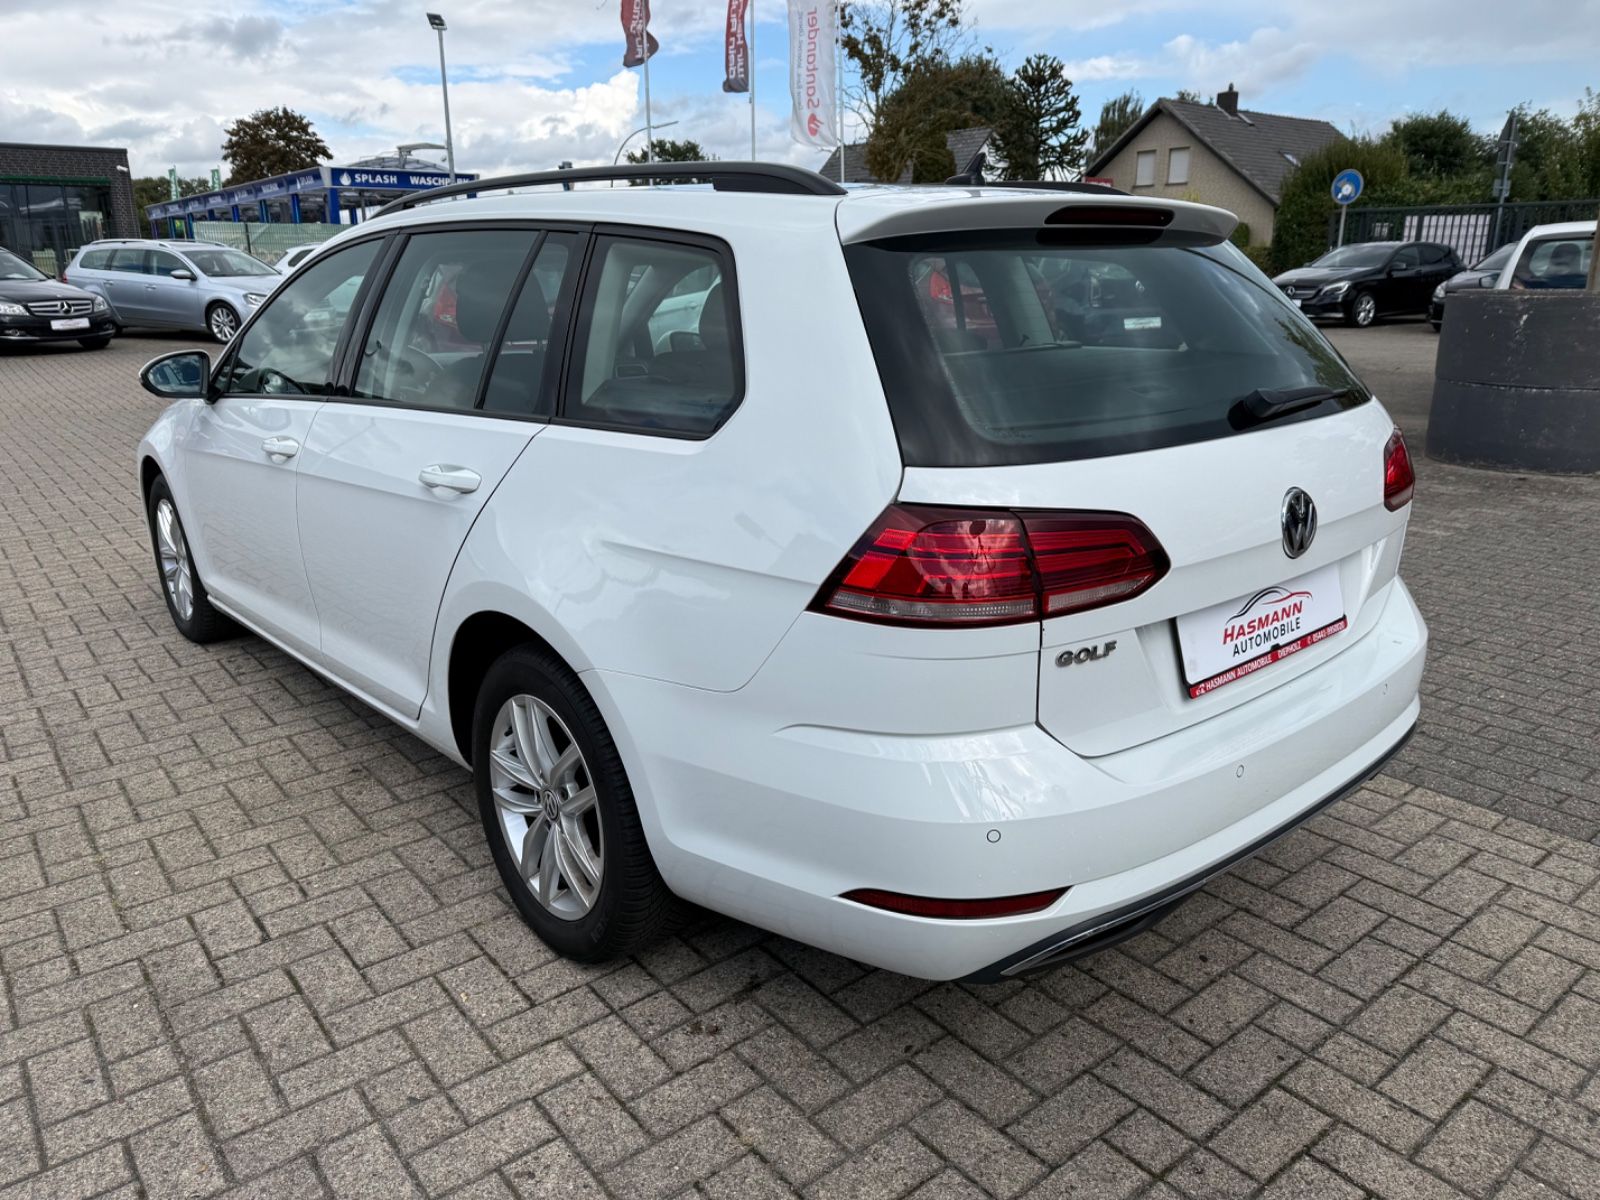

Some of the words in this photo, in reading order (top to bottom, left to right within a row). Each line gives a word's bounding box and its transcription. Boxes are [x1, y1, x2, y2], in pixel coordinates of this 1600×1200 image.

[354, 173, 398, 184] SPLASH
[1223, 600, 1302, 644] HASMANN
[1232, 617, 1301, 657] AUTOMOBILE
[1055, 640, 1118, 667] GOLF
[1205, 670, 1238, 690] HASMANN
[1236, 655, 1273, 678] AUTOMOBILE
